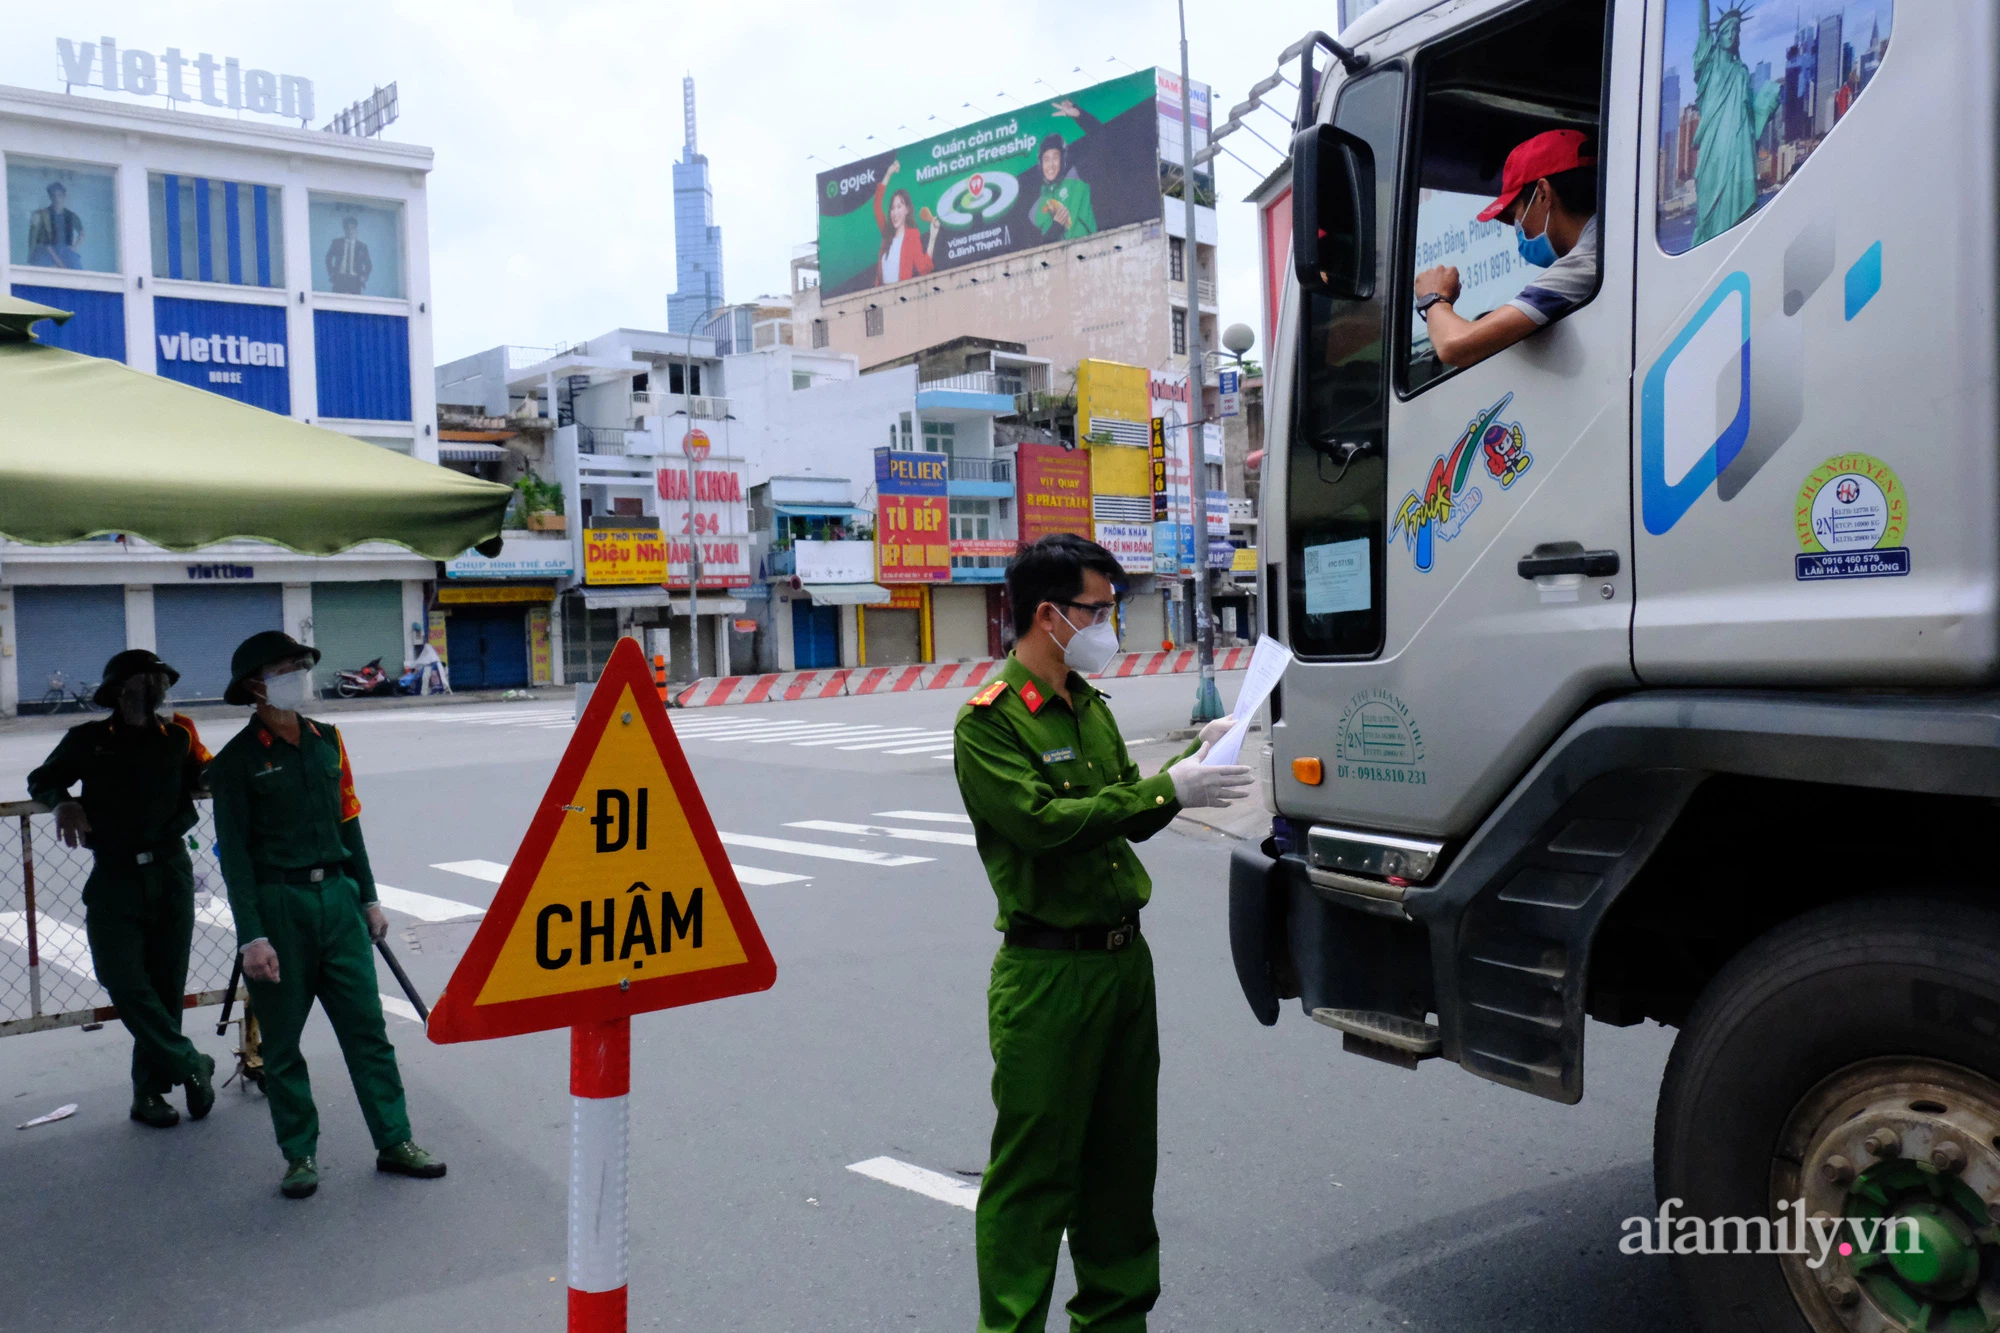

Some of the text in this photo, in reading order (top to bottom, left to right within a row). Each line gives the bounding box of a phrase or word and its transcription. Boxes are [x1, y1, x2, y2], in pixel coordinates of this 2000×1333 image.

[56, 36, 315, 120] viettien
[931, 118, 1018, 159] Quán còn mở
[950, 152, 975, 172] còn
[977, 134, 1037, 164] Freeship
[840, 169, 876, 195] gojek
[968, 227, 1002, 243] FREESHIP
[1423, 240, 1443, 266] Bạch
[1467, 268, 1473, 290] 3
[1475, 259, 1488, 286] 511
[1491, 250, 1511, 280] 8978
[159, 332, 286, 368] viettien
[209, 371, 243, 384] HOUSE
[890, 460, 944, 481] PELIER
[656, 468, 742, 503] NHA KHOA
[1058, 478, 1080, 489] QUAY
[681, 512, 720, 536] 294
[913, 498, 942, 531] BẾP
[588, 543, 665, 568] Diệu Nhi
[703, 543, 740, 565] XANH
[1121, 541, 1133, 553] NHI
[1822, 554, 1880, 566] 0916 460 579
[1826, 563, 1840, 575] HÀ
[1847, 563, 1868, 574] LÂM
[1357, 766, 1405, 783] 0918.810
[1408, 770, 1427, 785] 231
[590, 787, 648, 854] ĐI
[535, 881, 704, 970] CHẬM
